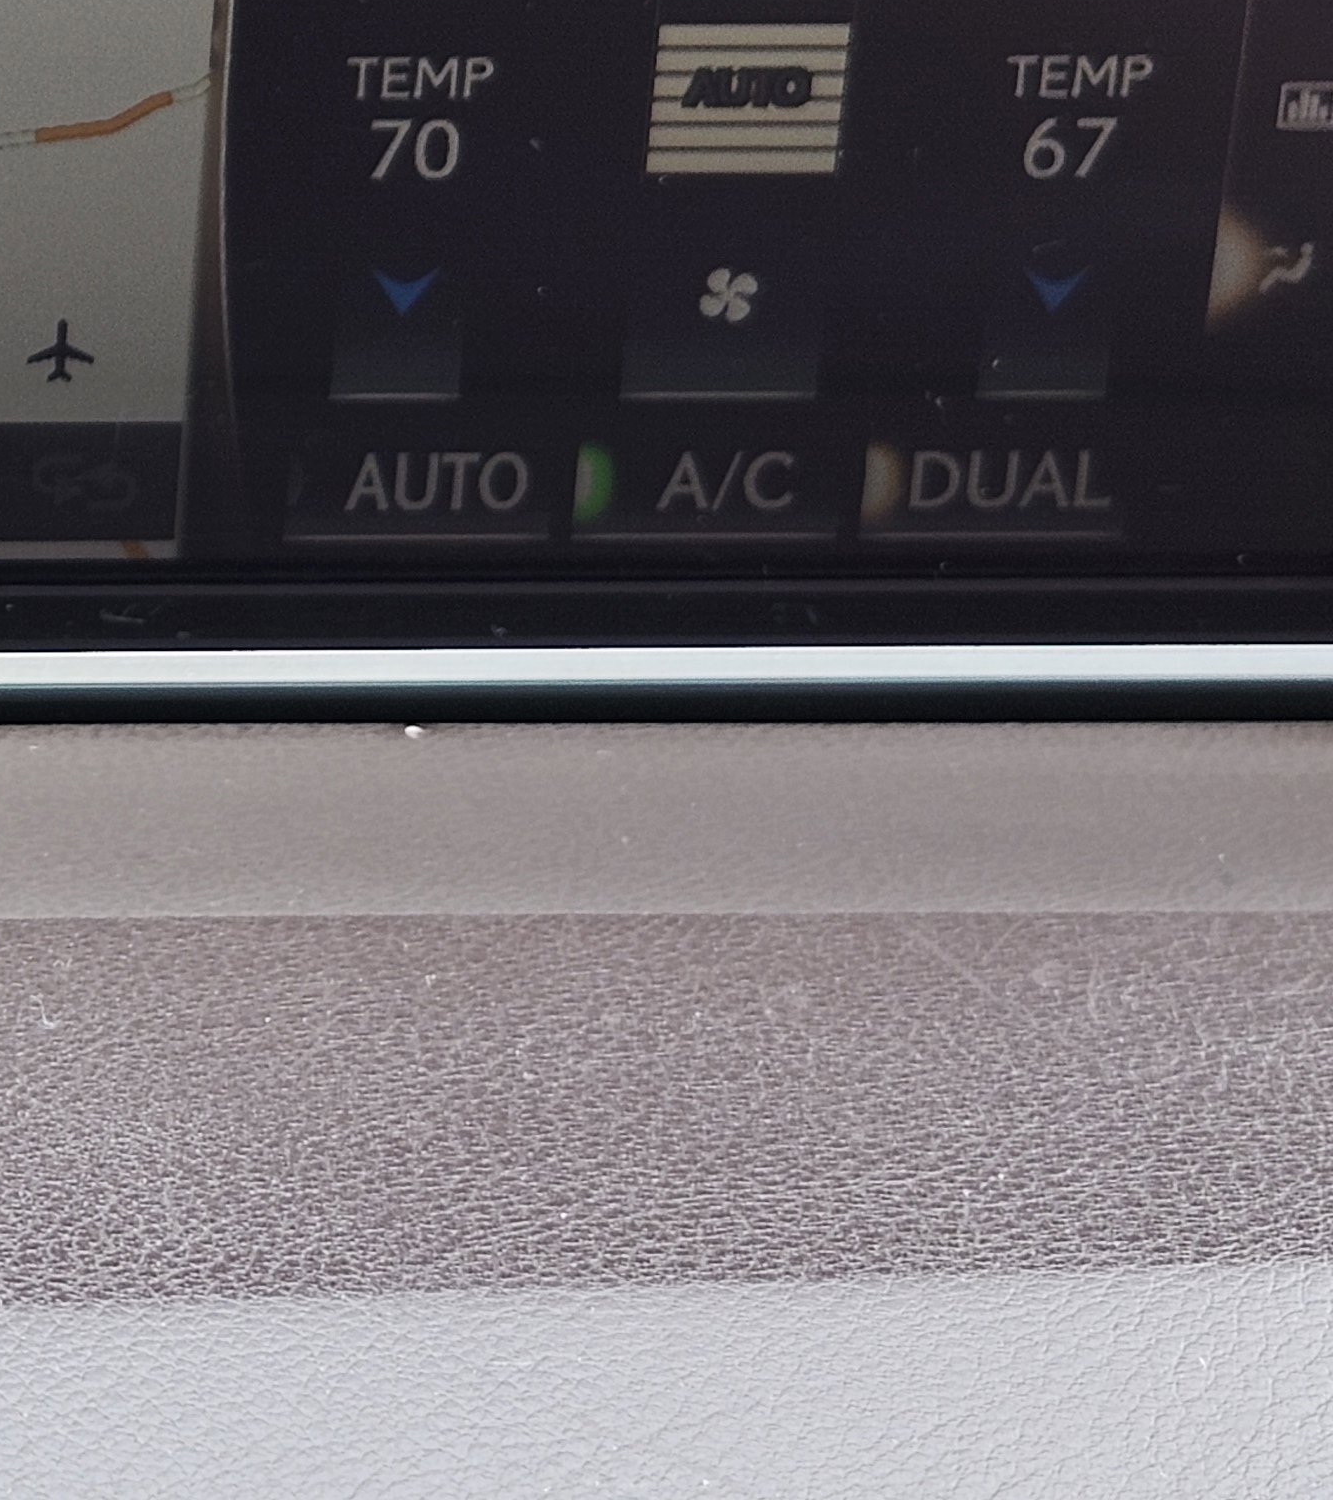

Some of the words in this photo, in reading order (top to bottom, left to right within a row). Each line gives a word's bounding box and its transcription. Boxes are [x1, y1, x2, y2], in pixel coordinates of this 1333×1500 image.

[346, 56, 494, 99] TEMP
[681, 66, 813, 108] AUTO
[1006, 54, 1154, 99] TEMP
[369, 118, 461, 181] 70
[1021, 116, 1119, 180] 67
[344, 452, 528, 513] AUTO
[655, 450, 796, 512] A/C
[908, 450, 1113, 509] DUAL
